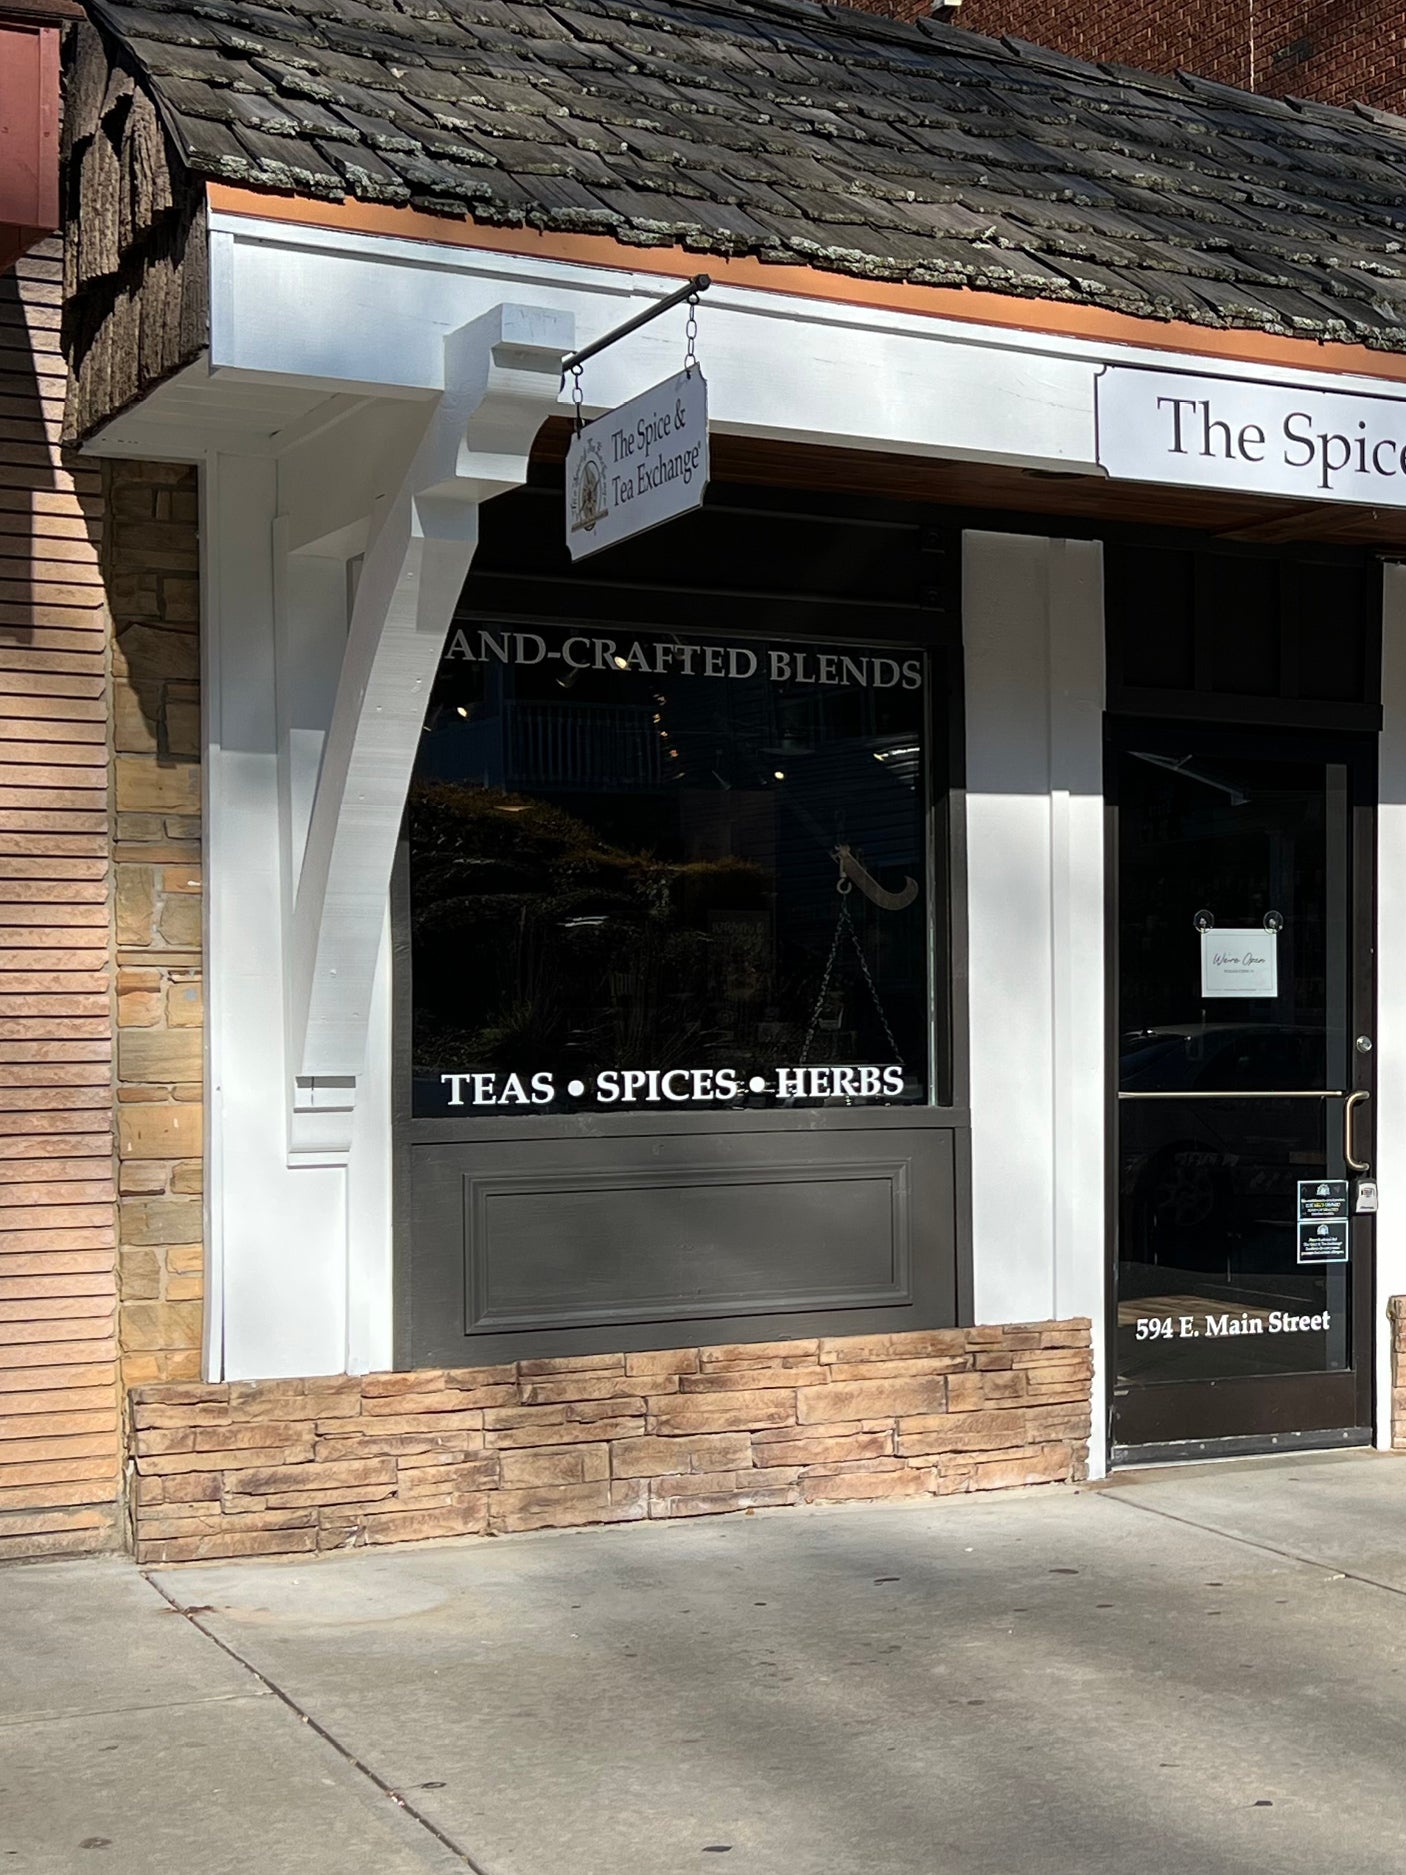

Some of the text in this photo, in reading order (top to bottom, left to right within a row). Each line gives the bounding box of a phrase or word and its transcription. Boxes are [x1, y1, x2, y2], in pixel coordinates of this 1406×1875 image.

[611, 398, 686, 463] The Spice &
[1156, 396, 1266, 462] The
[611, 475, 634, 507] Tea
[443, 628, 922, 689] AND-CRAFTED BLENDS
[441, 1066, 905, 1106] TEAS SPICES HERBS
[1135, 1310, 1331, 1341] 594 E. Main Street
